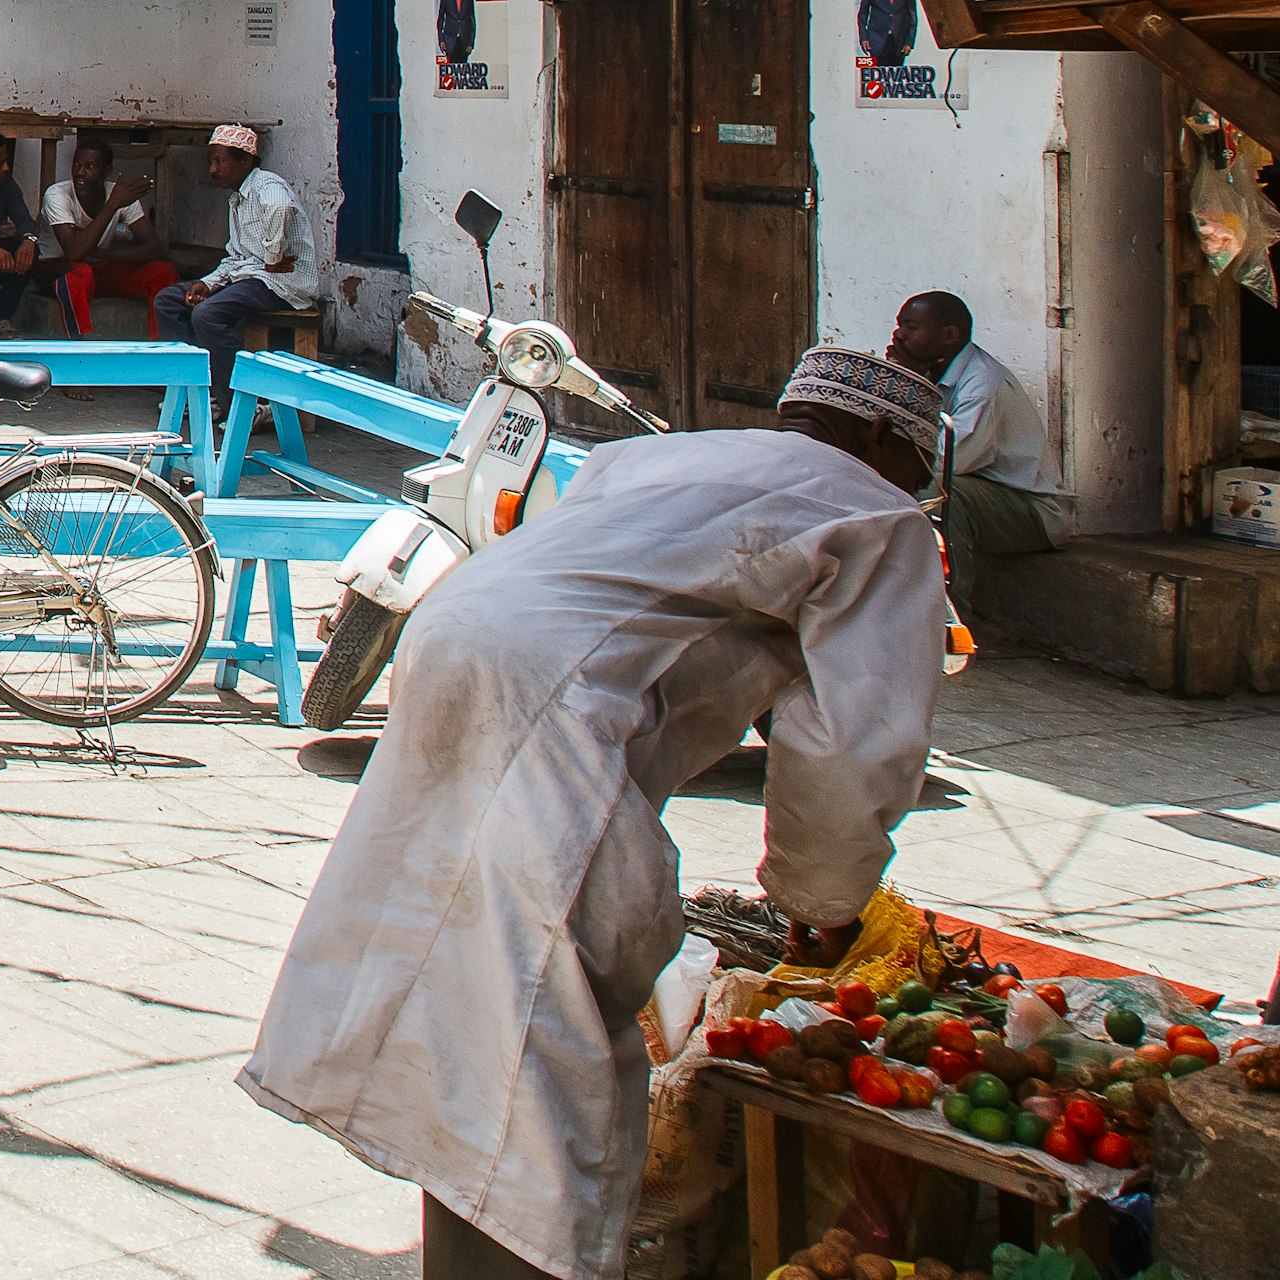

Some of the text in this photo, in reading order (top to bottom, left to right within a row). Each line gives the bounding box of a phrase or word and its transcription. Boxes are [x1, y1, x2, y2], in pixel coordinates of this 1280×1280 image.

[439, 63, 488, 77] EDWARD
[860, 66, 936, 82] EDWARD
[497, 434, 525, 457] AM
